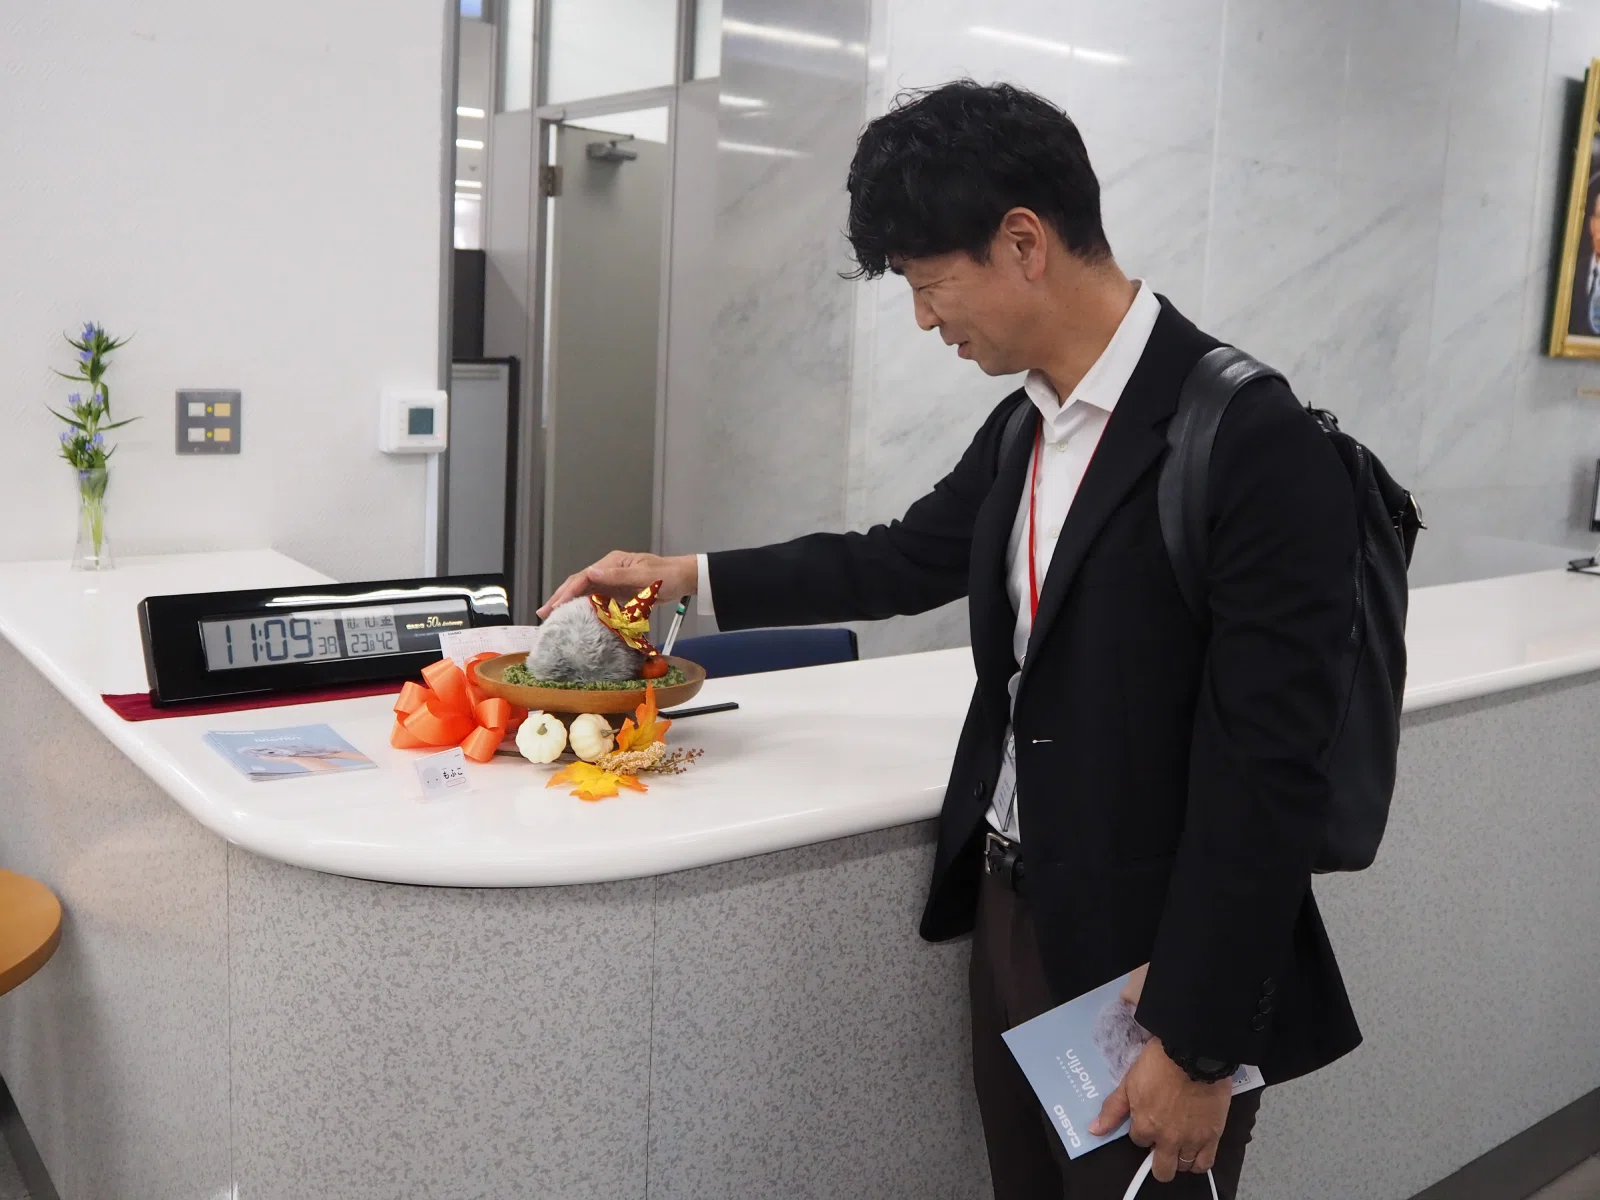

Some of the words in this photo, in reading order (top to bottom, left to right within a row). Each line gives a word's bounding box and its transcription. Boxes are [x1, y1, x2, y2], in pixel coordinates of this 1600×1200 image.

[225, 618, 314, 665] 11:09
[317, 635, 338, 655] 38
[1065, 1048, 1099, 1099] Moflin
[1053, 1104, 1082, 1148] CASIO
